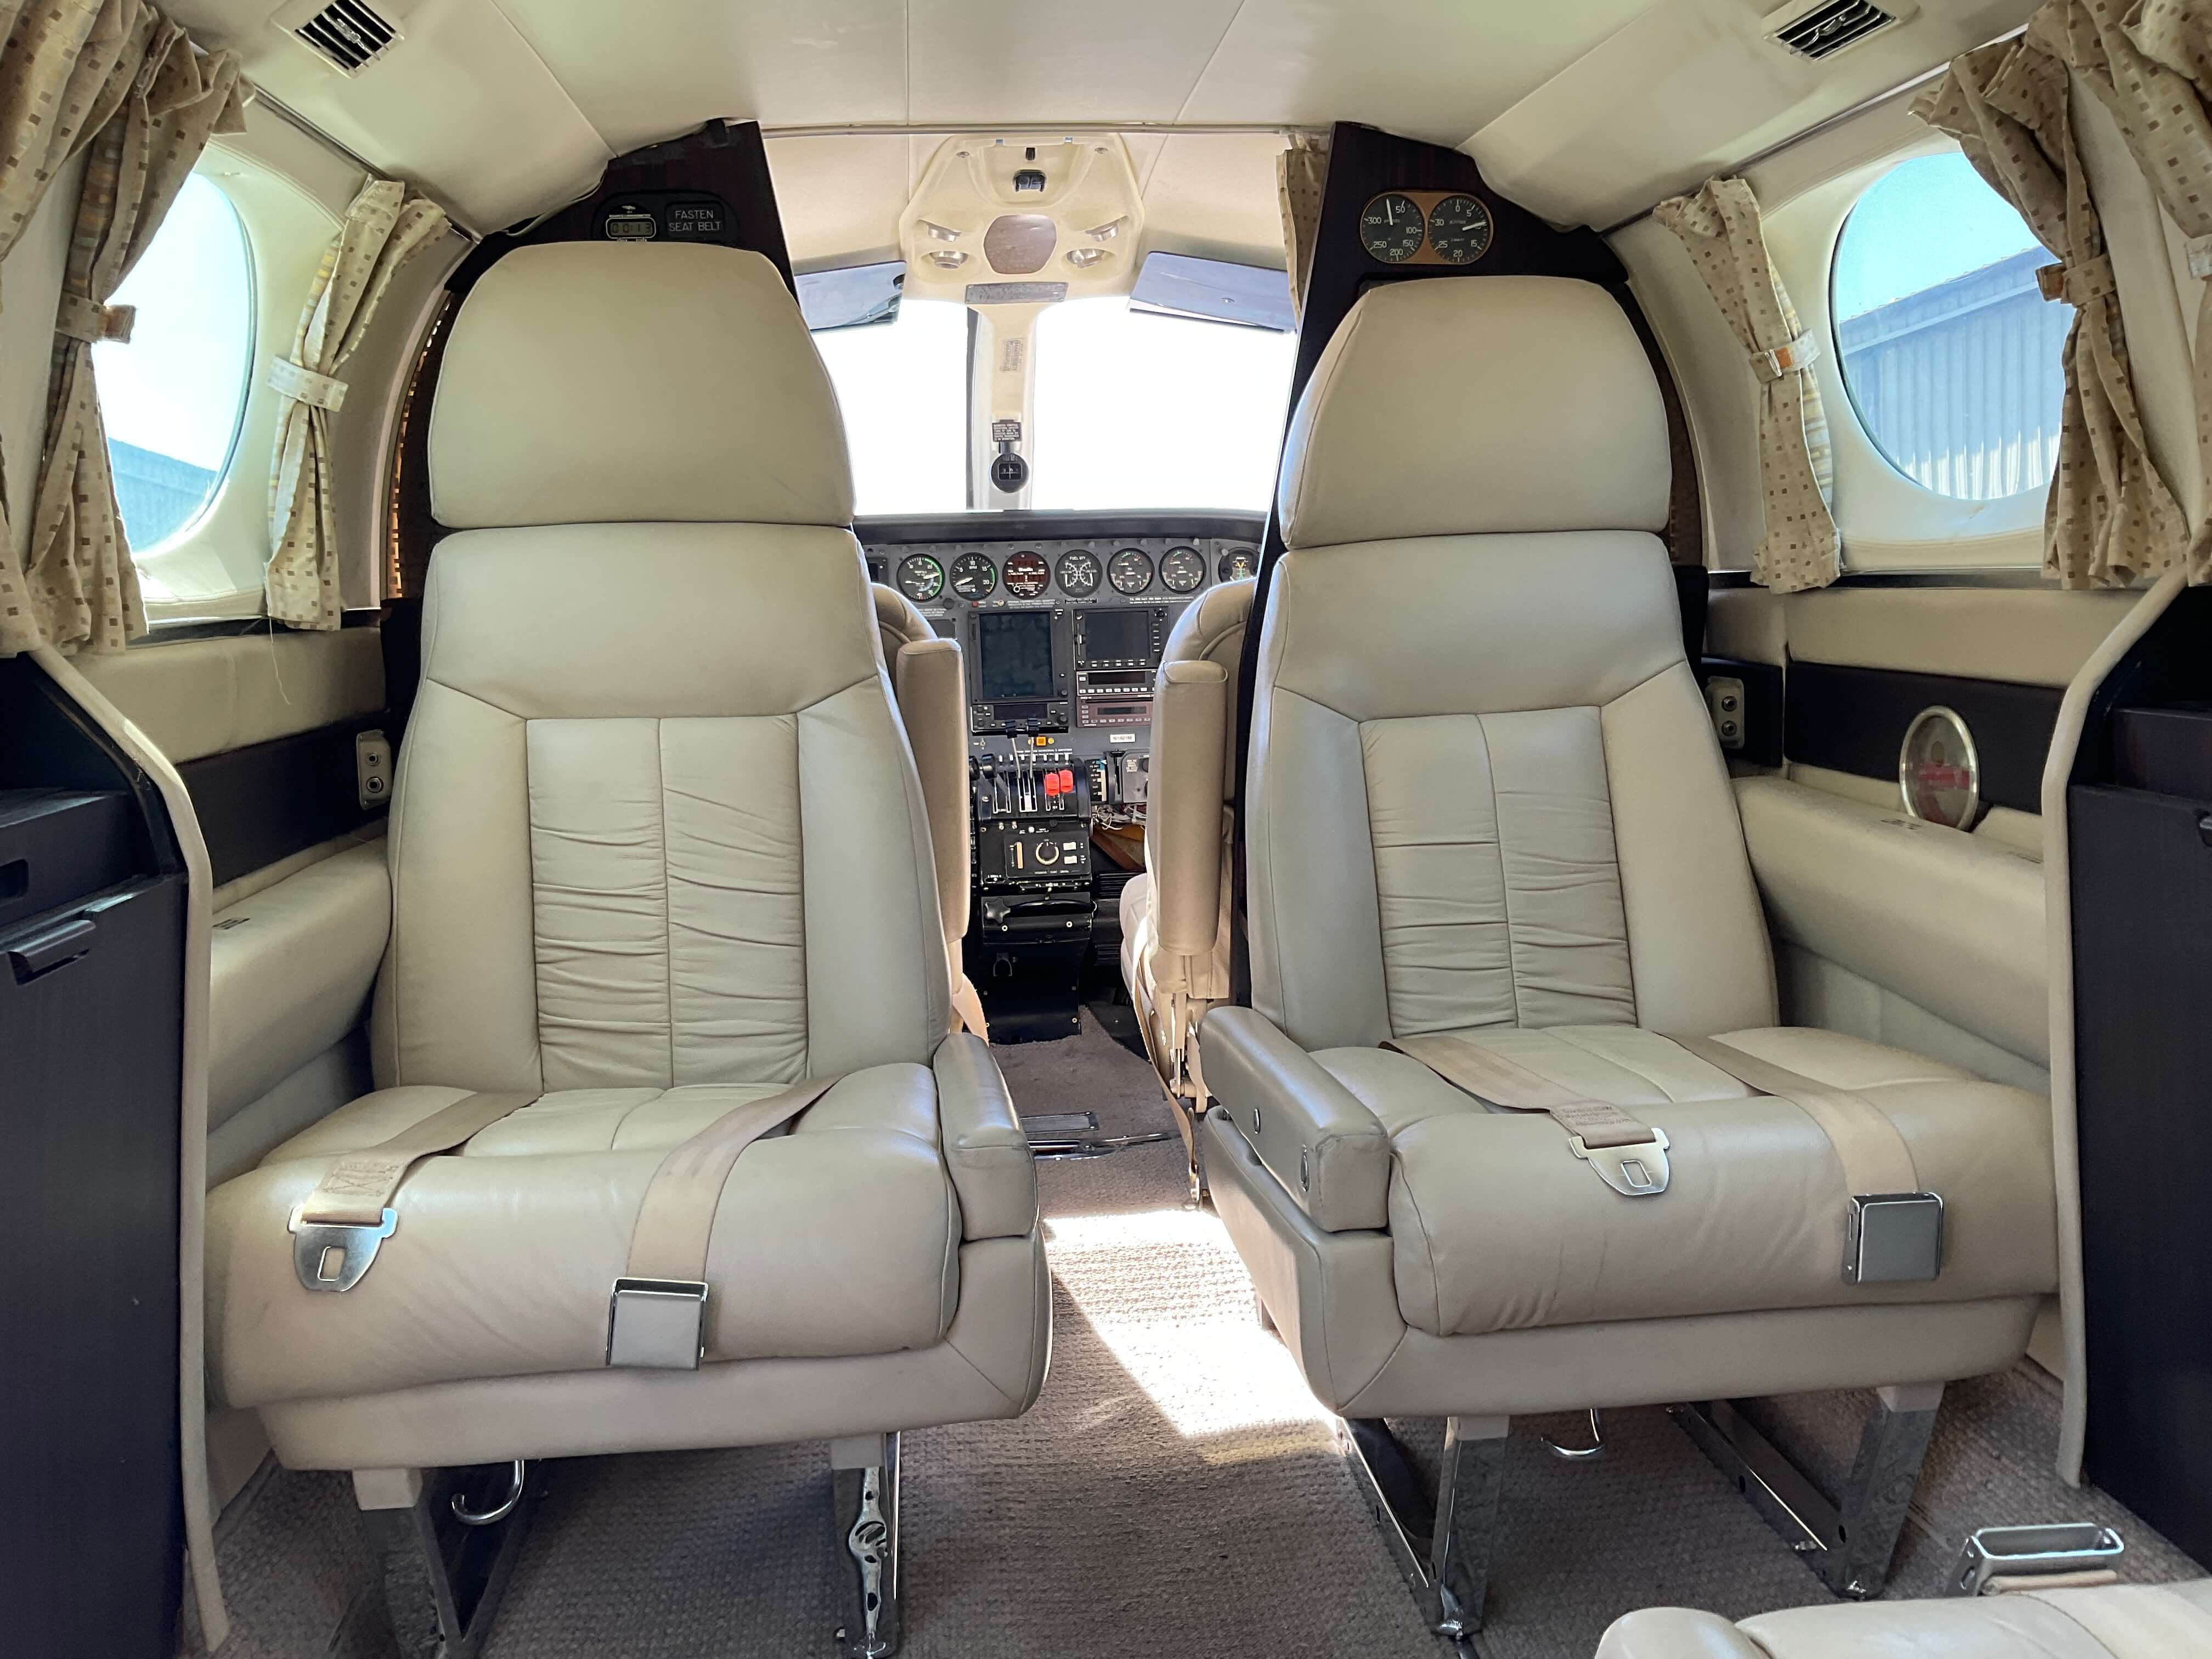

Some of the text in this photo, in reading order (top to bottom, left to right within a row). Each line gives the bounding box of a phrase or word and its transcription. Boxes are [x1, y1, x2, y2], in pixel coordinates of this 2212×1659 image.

[675, 210, 714, 219] FASTEN
[669, 221, 721, 232] SEAT BELT
[1438, 240, 1448, 249] 25
